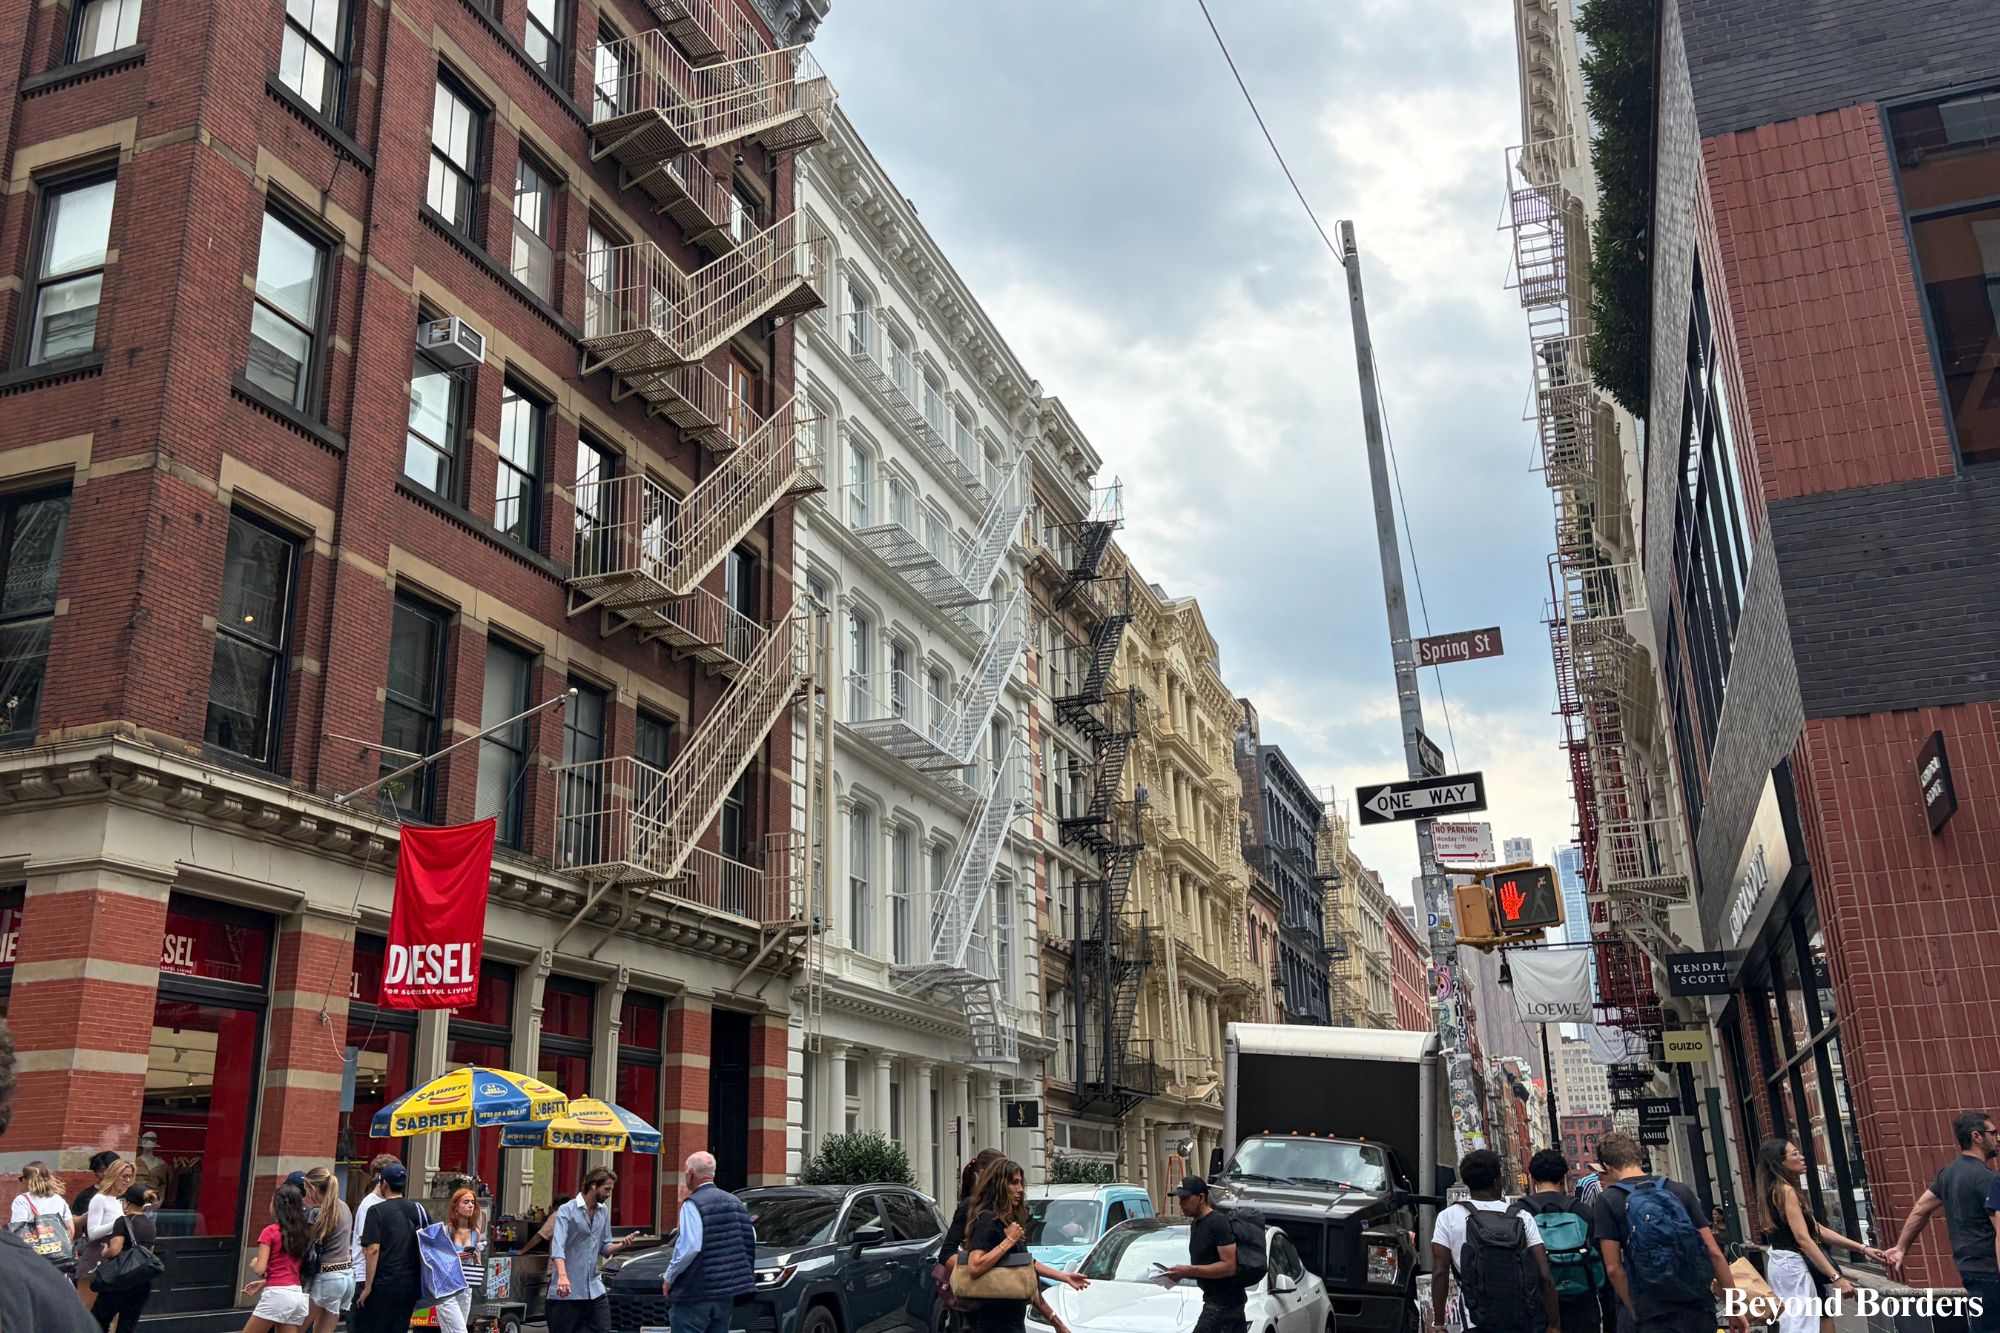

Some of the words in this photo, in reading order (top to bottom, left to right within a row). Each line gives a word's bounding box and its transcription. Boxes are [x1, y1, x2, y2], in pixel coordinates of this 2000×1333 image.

[1422, 640, 1469, 663] Spring
[1474, 634, 1491, 653] St
[1377, 793, 1413, 811] ONE
[1429, 786, 1467, 805] WAY
[1462, 835, 1478, 843] Friday
[161, 934, 194, 967] SEL
[385, 943, 474, 985] DIESEL
[1681, 974, 1726, 984] SCOTT
[1528, 1003, 1582, 1015] LOEWE
[1669, 1042, 1703, 1051] GUIZIO
[416, 1084, 468, 1102] SABRETT
[1647, 1102, 1671, 1113] ami
[395, 1111, 468, 1131] SABRETT
[552, 1132, 623, 1147] SABRETT
